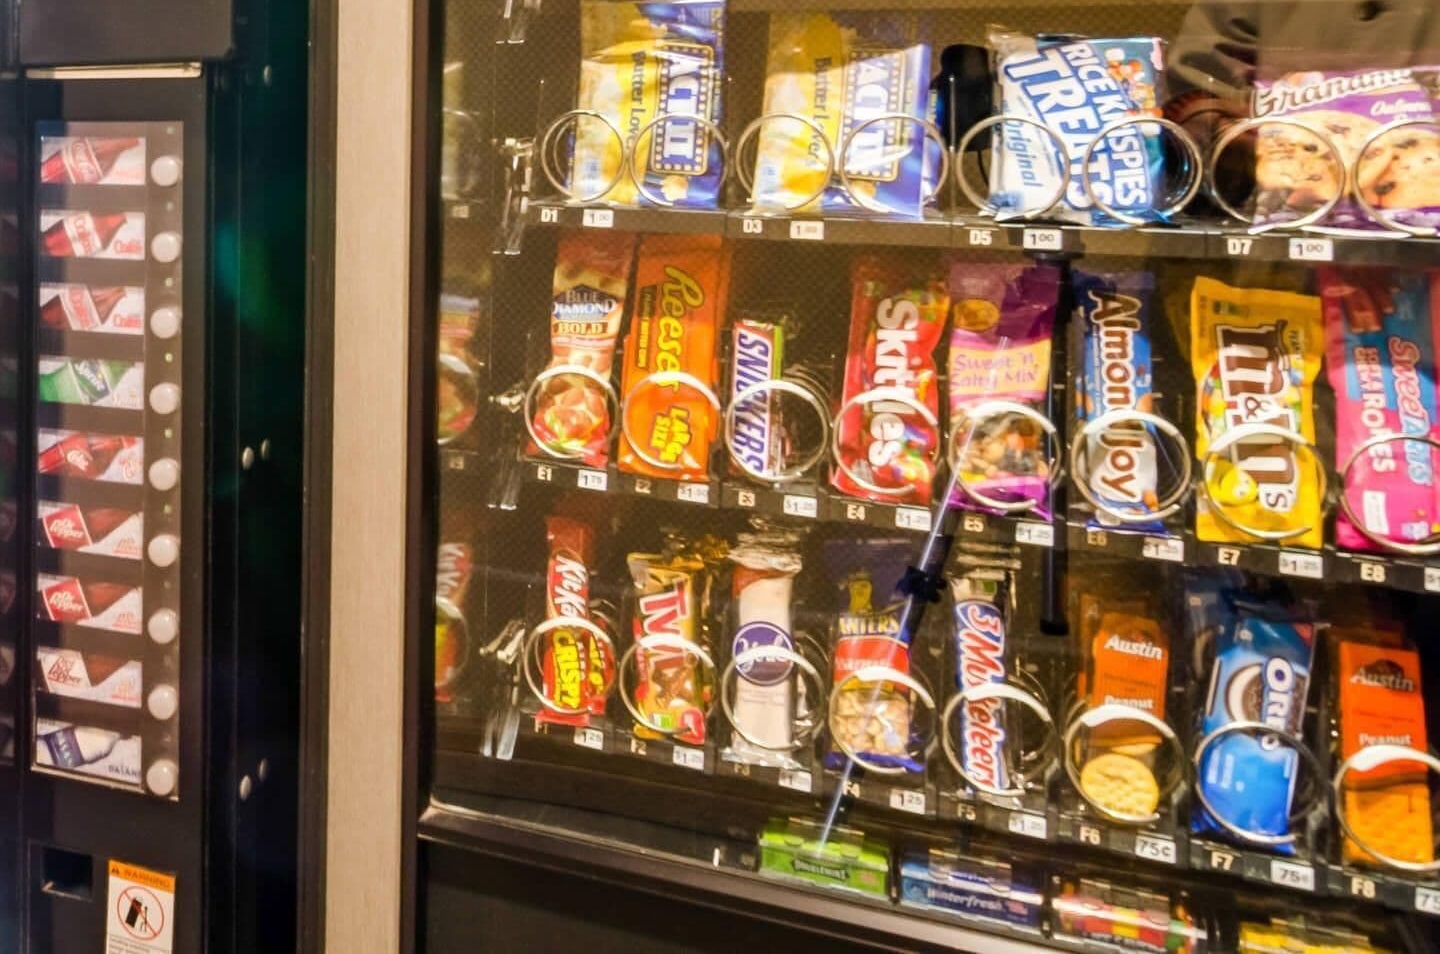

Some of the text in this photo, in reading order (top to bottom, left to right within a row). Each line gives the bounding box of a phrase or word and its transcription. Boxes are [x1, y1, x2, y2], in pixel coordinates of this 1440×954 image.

[1060, 43, 1122, 95] RICE
[624, 108, 647, 150] Love
[540, 208, 559, 223] D1
[969, 229, 993, 246] D5
[1227, 238, 1253, 255] D7
[558, 321, 605, 335] BOLD
[867, 297, 920, 467] Skittles
[734, 331, 770, 474] SNICKERS
[537, 466, 553, 482] E1
[1099, 432, 1145, 500] Joy
[846, 503, 866, 521] E4
[963, 516, 984, 533] E5
[1218, 546, 1241, 566] E7
[1360, 562, 1386, 583] E8
[1103, 633, 1163, 660] Austin
[1349, 665, 1415, 693] Austin
[962, 603, 1003, 789] 3 Musketeers
[1261, 656, 1294, 751] OREO
[630, 738, 647, 756] F2
[1079, 826, 1101, 846] F6
[1211, 851, 1234, 871] F7
[1351, 876, 1377, 899] F8
[925, 884, 1006, 914] Winterfresh
